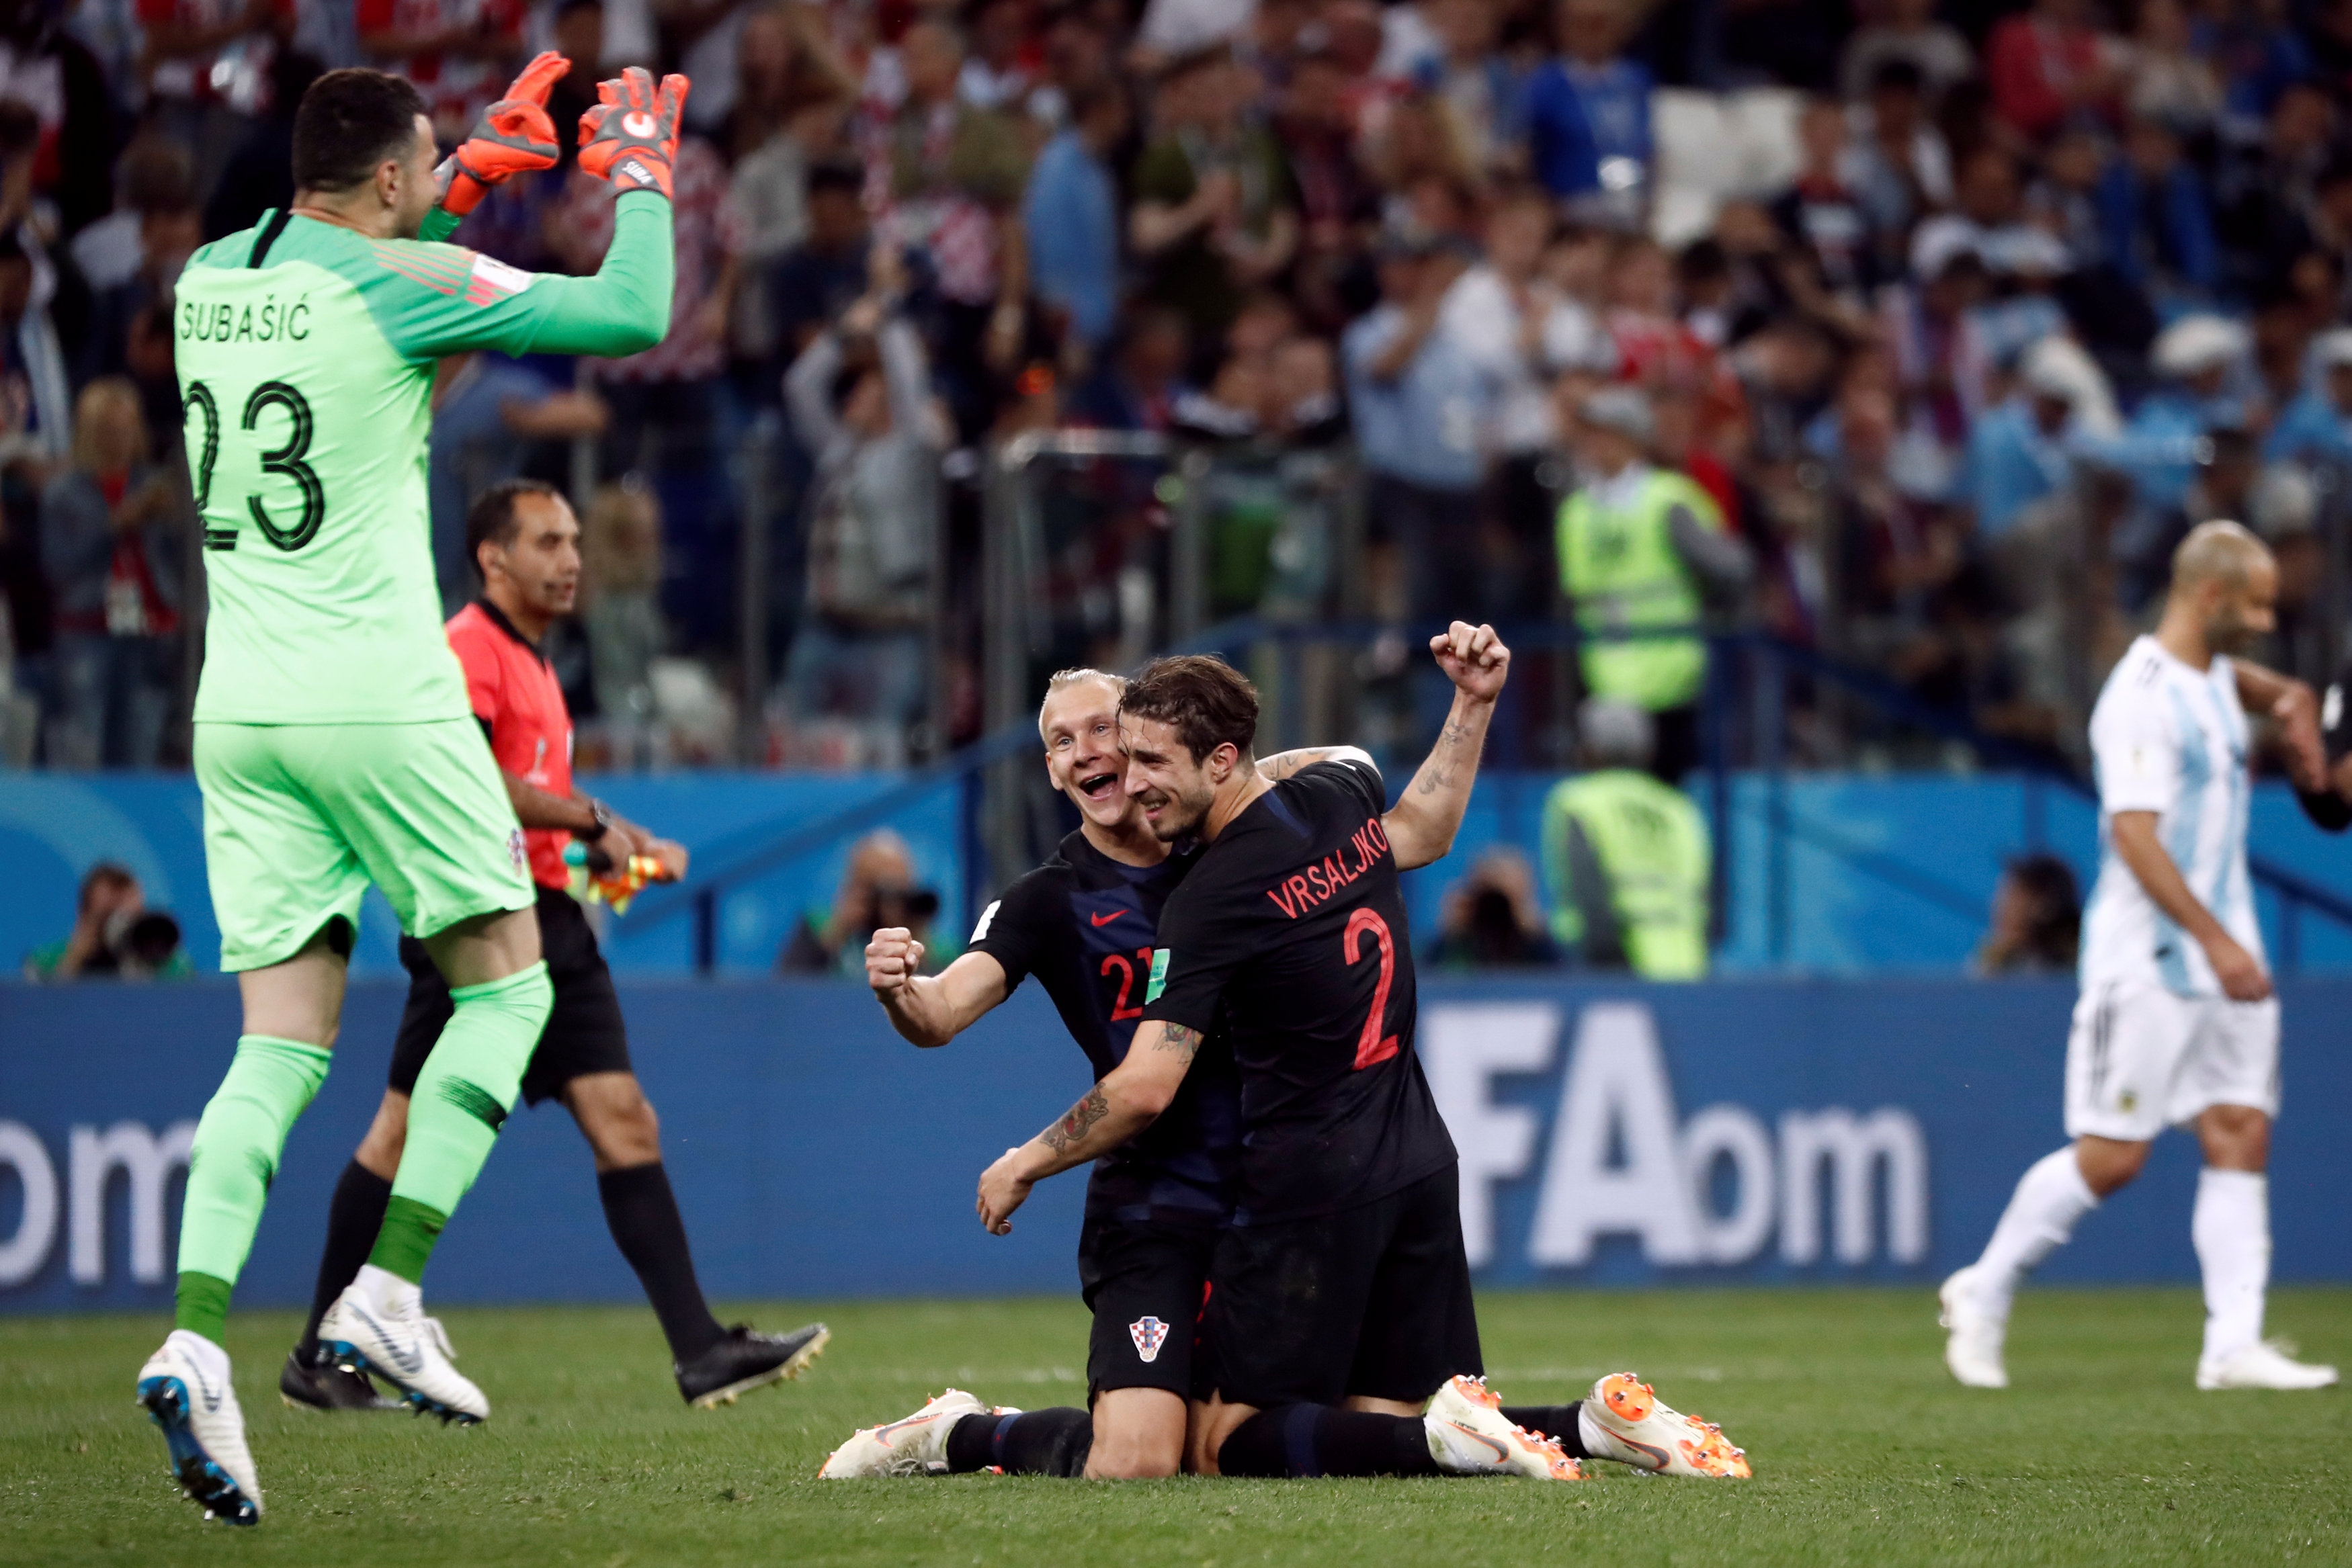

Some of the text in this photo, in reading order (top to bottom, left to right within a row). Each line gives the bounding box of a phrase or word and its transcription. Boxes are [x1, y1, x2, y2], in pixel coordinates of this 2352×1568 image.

[180, 293, 310, 343] SUBAŠIĆ
[183, 381, 325, 552] 23
[1267, 818, 1388, 919] VRSALJKO
[1344, 907, 1399, 1070] 2
